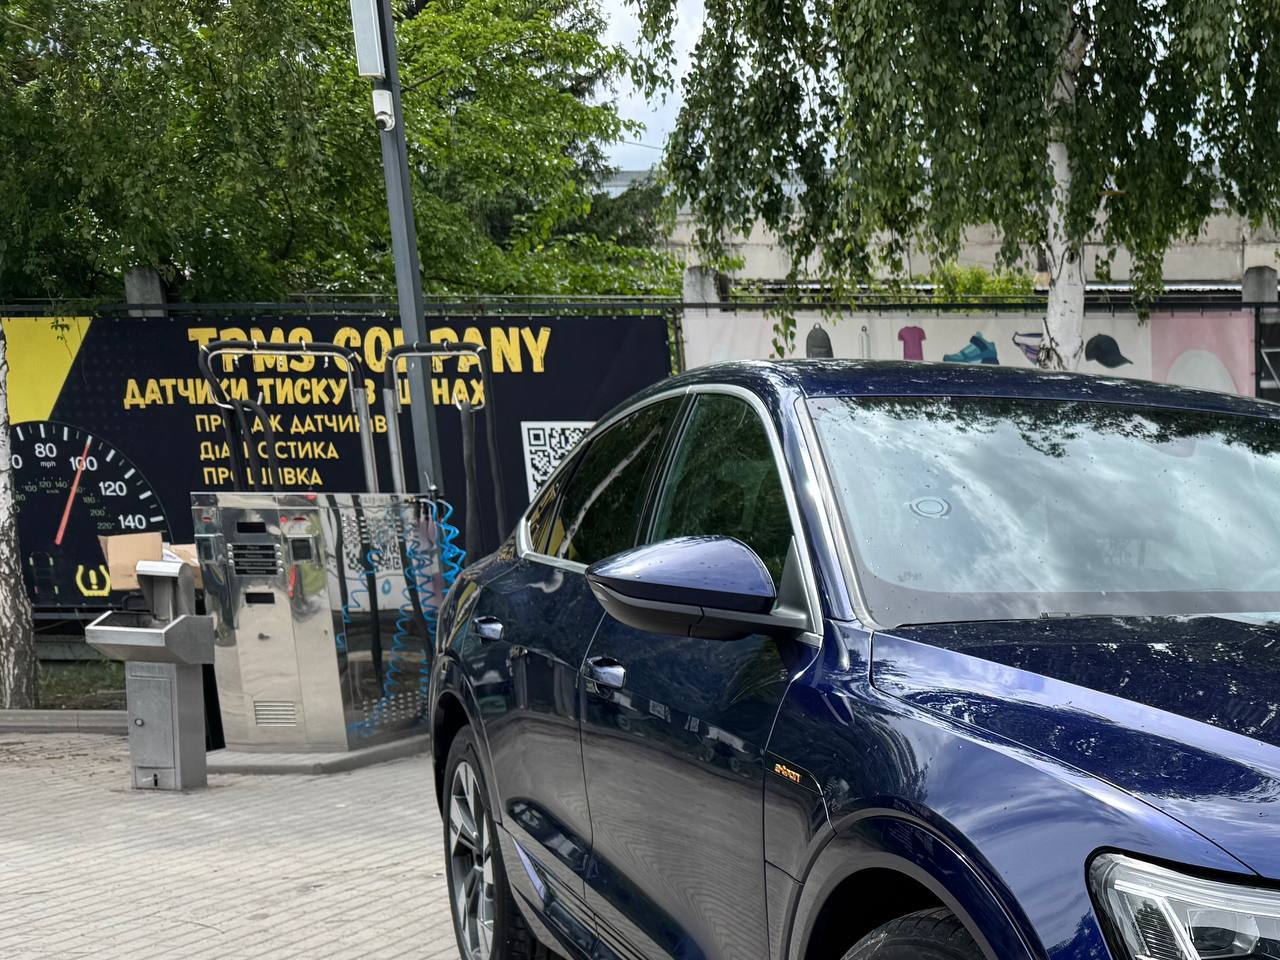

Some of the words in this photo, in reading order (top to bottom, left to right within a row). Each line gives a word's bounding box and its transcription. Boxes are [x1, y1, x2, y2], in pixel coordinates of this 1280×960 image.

[257, 377, 348, 405] ТИСКУ
[34, 443, 57, 458] 80
[40, 460, 56, 468] mph
[69, 456, 98, 471] 100
[99, 481, 127, 496] 120
[118, 514, 147, 530] 140
